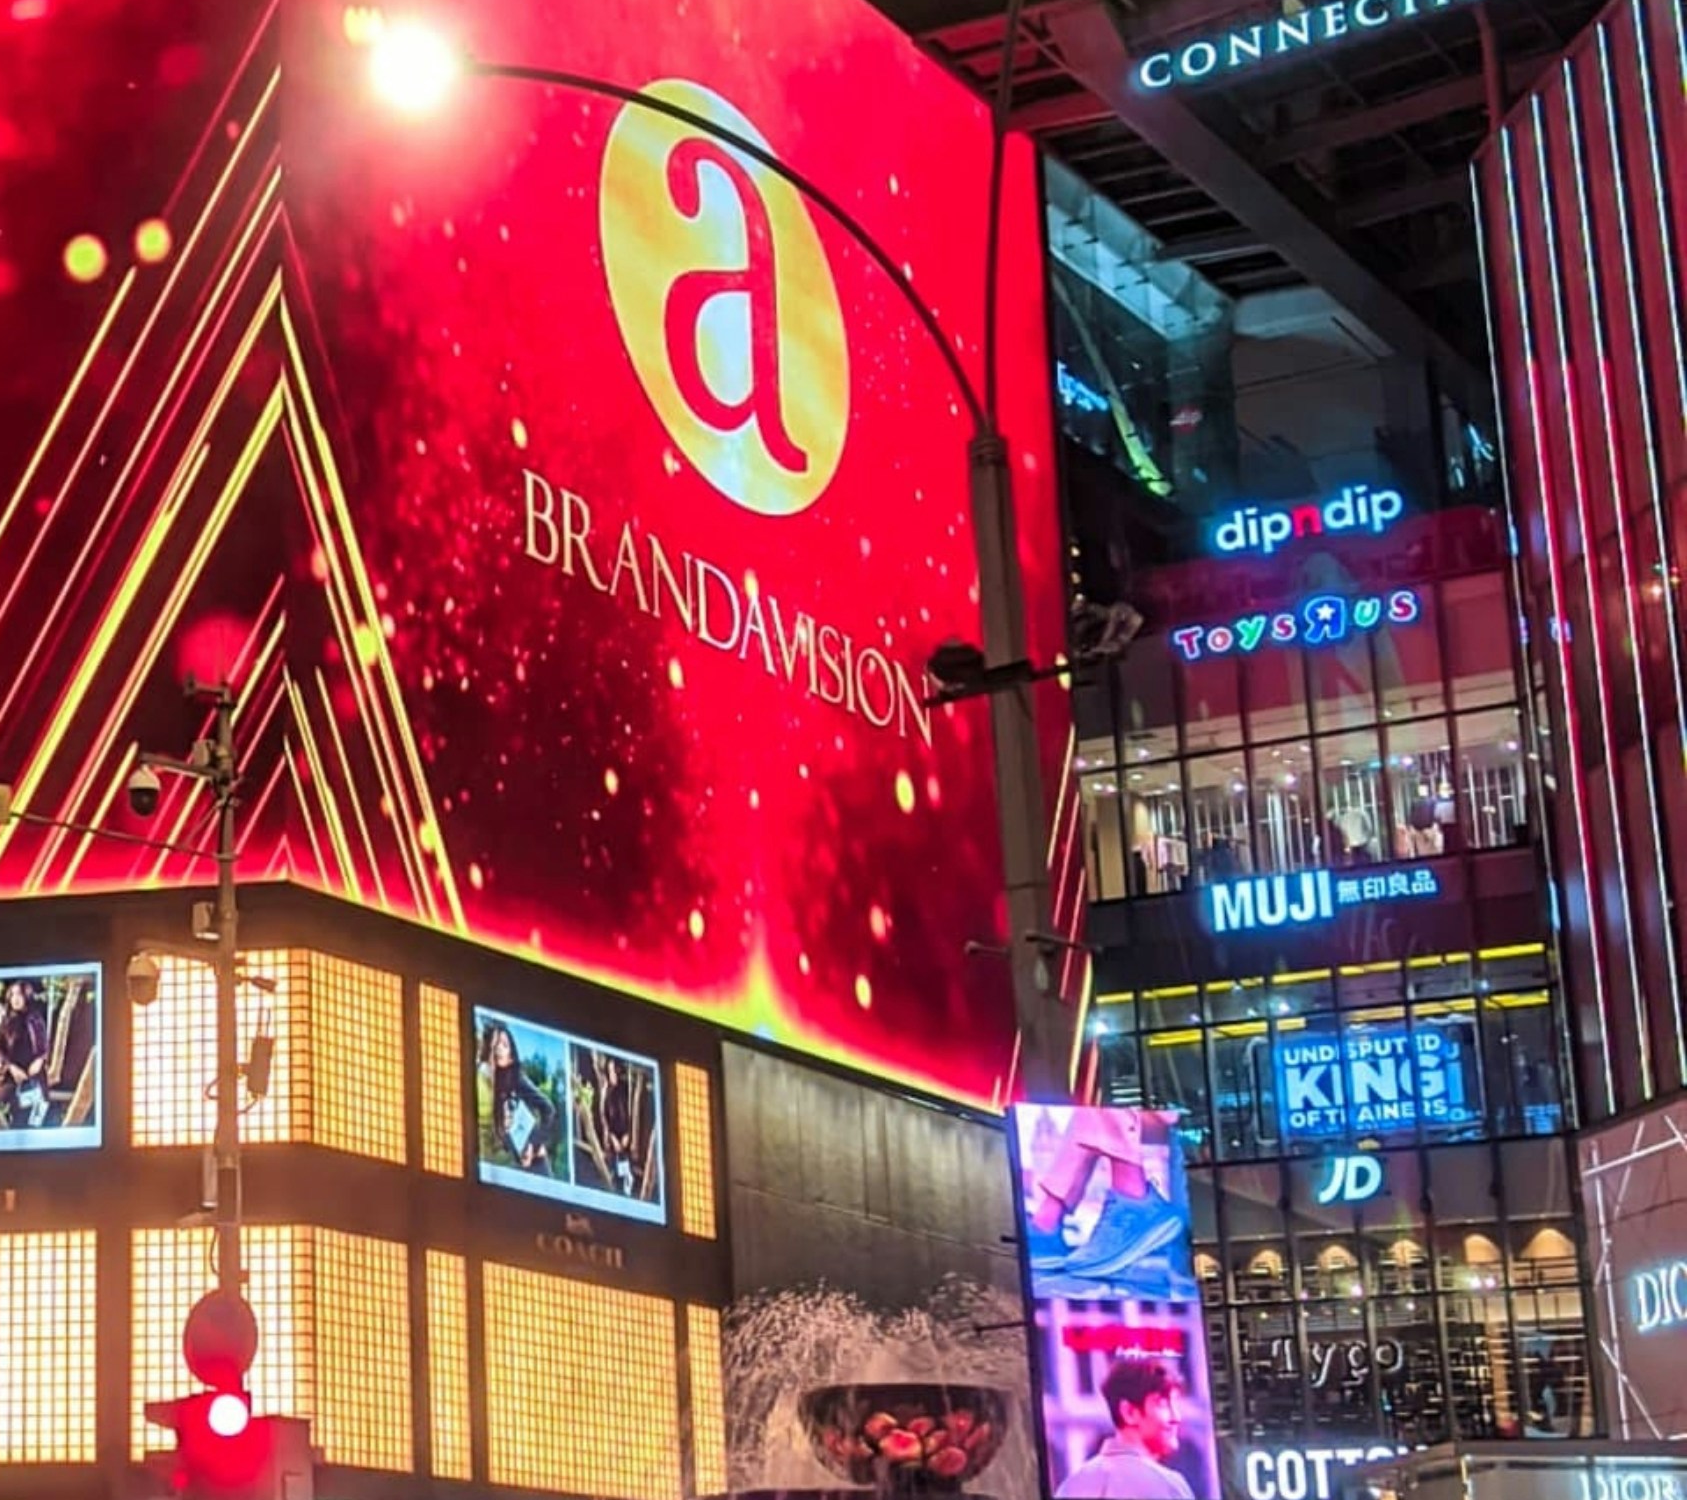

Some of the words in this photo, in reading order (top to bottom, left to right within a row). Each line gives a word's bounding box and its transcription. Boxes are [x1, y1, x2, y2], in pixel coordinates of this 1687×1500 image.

[1215, 484, 1403, 553] dipndip
[522, 468, 932, 749] BRANDAVISION
[1212, 870, 1334, 933] MUJI
[1337, 870, 1437, 904] 無印良品
[1285, 1054, 1446, 1110] KING
[1289, 1111, 1321, 1129] OF
[1318, 1155, 1382, 1204] JD
